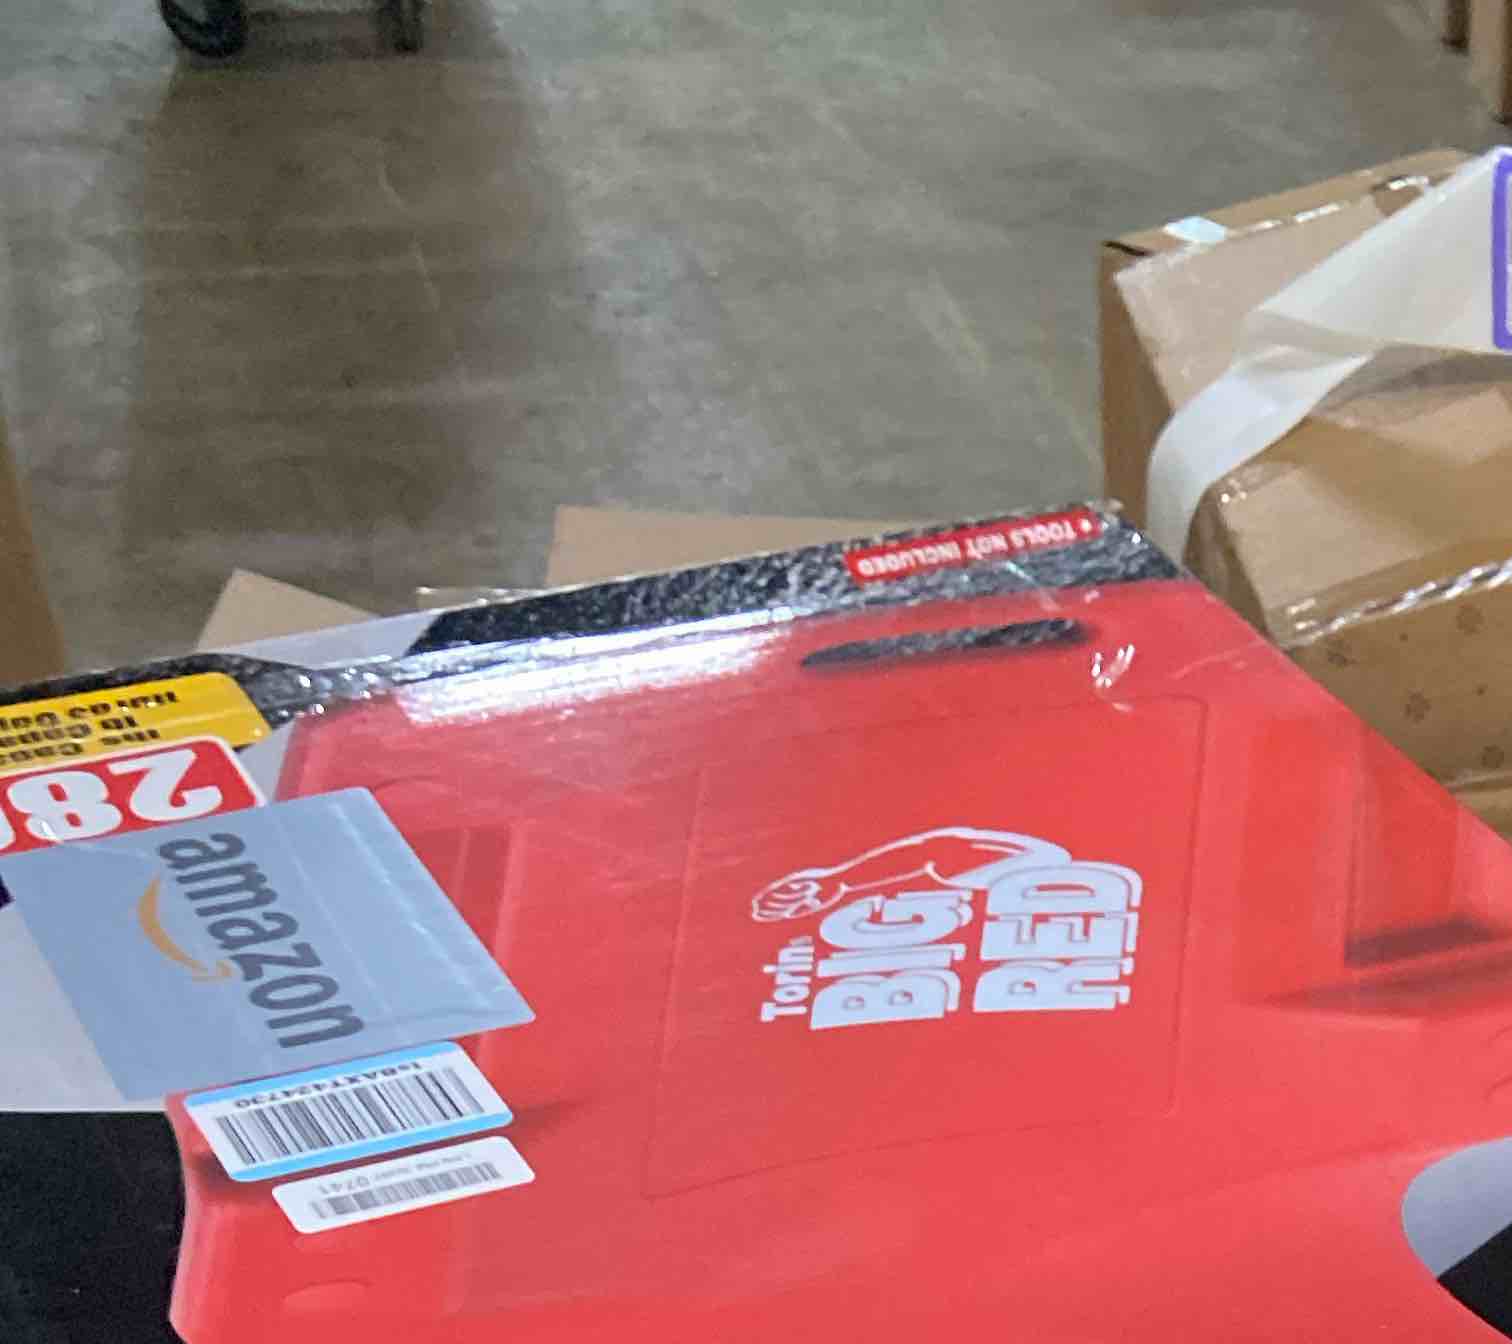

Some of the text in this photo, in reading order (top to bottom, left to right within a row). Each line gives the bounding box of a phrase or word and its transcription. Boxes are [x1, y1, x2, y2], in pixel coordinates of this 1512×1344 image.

[857, 519, 1078, 576] TOOLS NOT INCLUDED
[0, 748, 223, 850] 28
[159, 832, 366, 1049] amazon
[760, 935, 814, 1023] Torin
[810, 889, 973, 1030] BIG
[973, 860, 1143, 1013] RED
